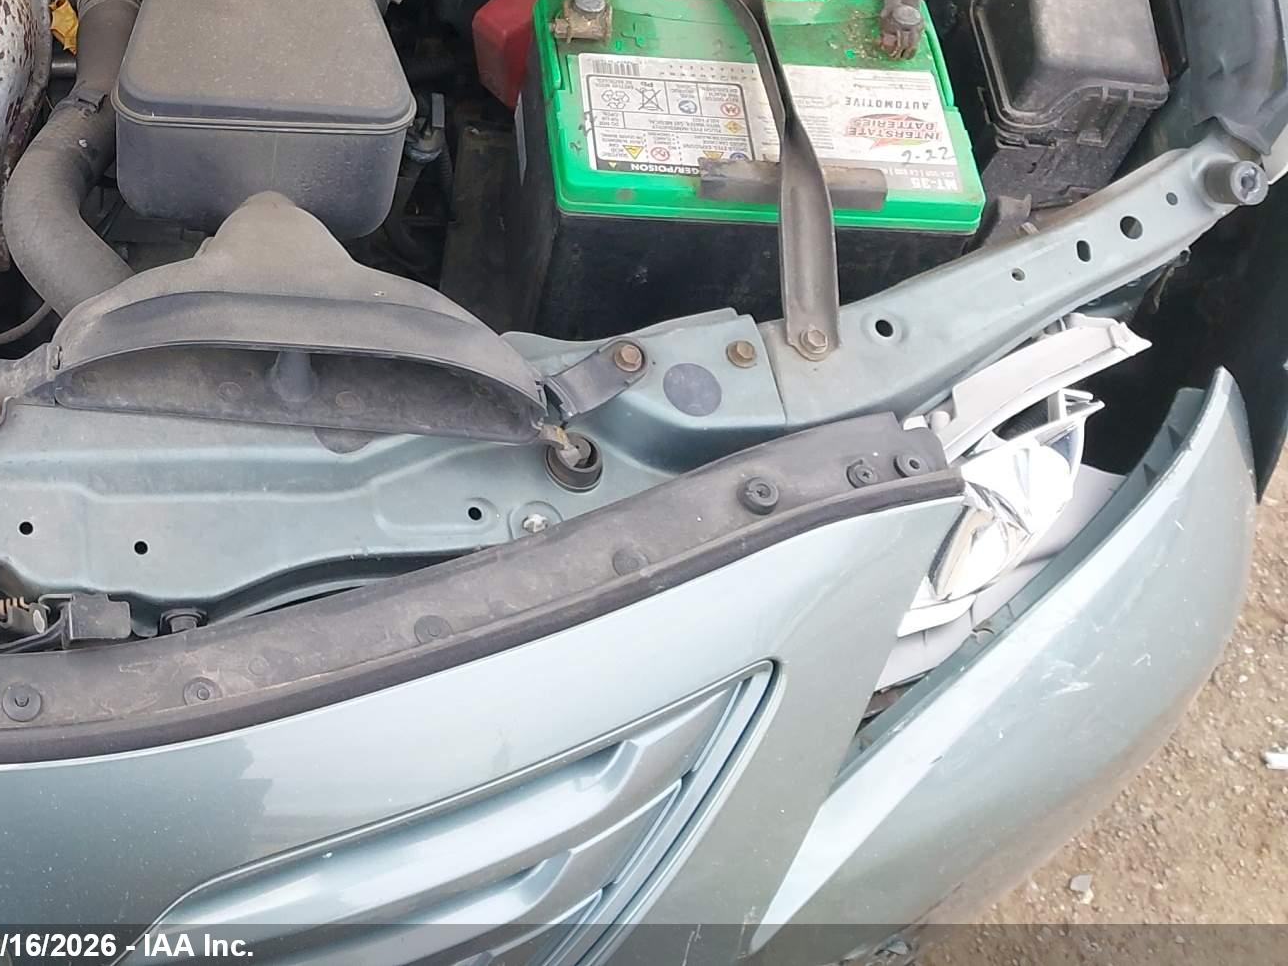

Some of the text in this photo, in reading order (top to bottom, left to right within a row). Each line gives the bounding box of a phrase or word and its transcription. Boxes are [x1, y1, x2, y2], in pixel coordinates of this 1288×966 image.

[844, 96, 929, 110] AUTOMOTIVE
[853, 119, 935, 131] BATTERIES
[848, 127, 940, 140] INTERSTATE
[631, 163, 700, 175] GER/POISON
